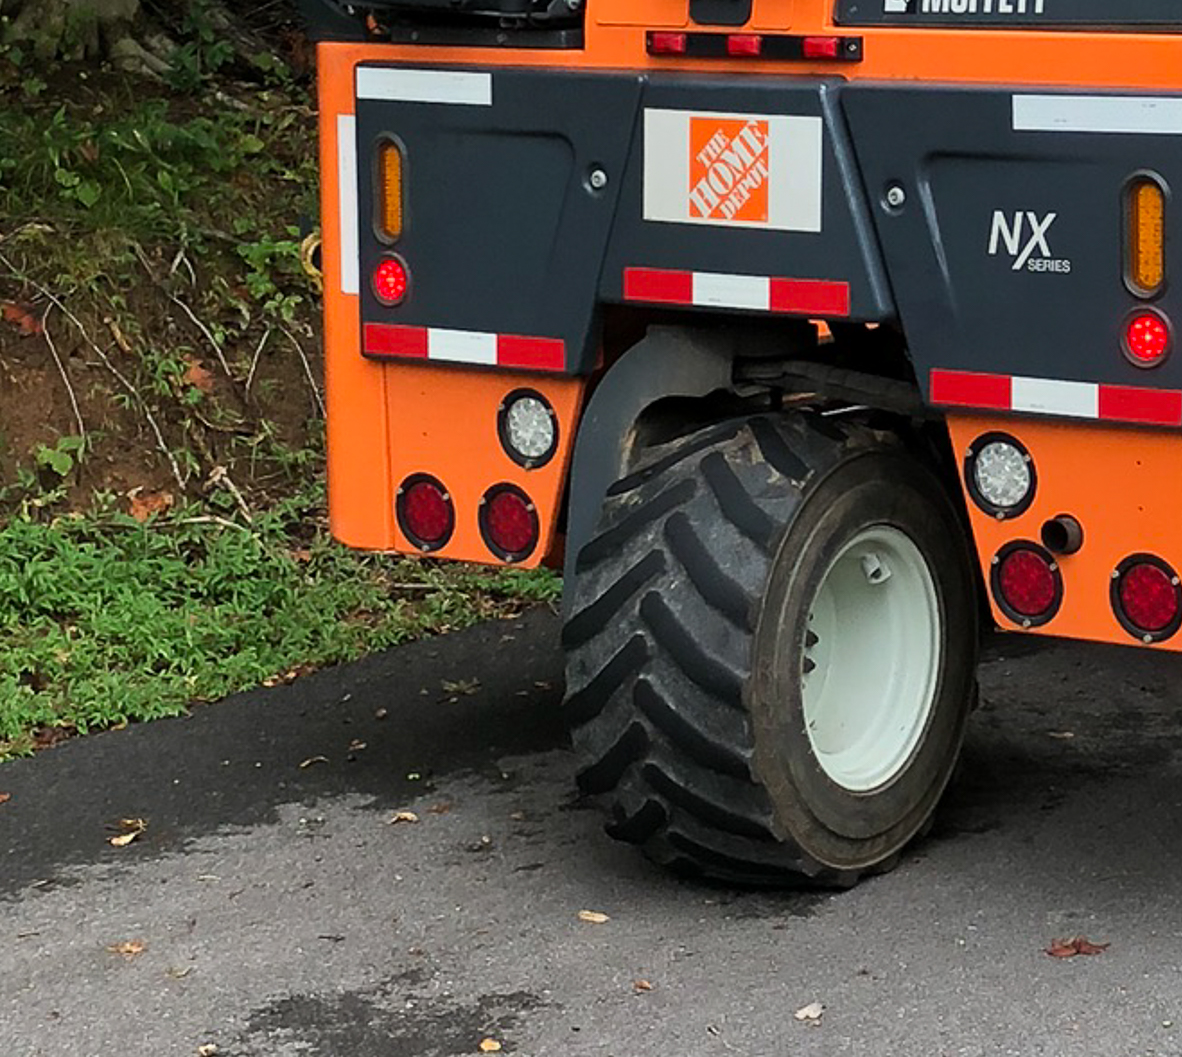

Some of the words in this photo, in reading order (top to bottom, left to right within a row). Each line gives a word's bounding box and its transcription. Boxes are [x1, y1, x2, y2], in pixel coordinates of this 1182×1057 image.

[689, 119, 770, 218] HOME
[696, 129, 731, 168] THE
[719, 158, 770, 220] DEPOT
[988, 210, 1057, 270] NX
[1027, 258, 1071, 273] SERIES
